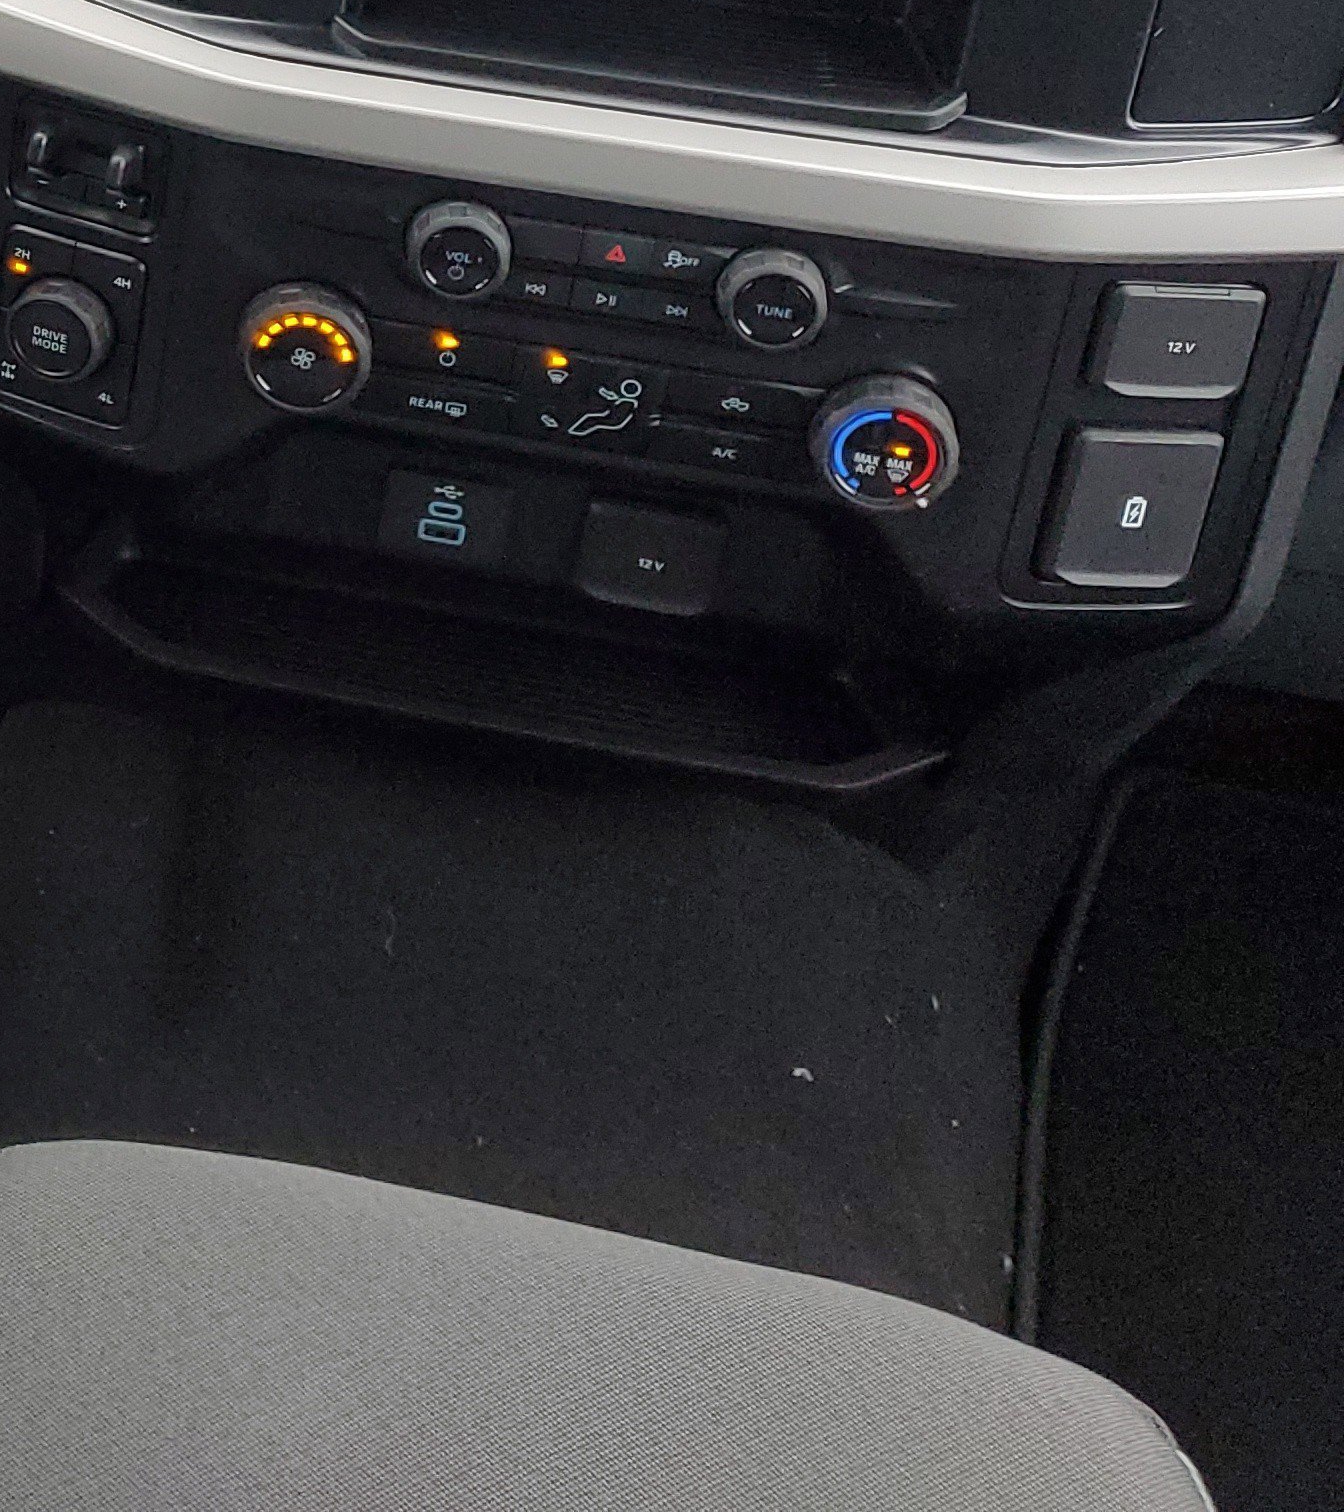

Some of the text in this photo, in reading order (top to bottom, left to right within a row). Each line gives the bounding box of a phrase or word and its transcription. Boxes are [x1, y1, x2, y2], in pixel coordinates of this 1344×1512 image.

[13, 247, 30, 260] 2H
[445, 250, 471, 264] VOL
[113, 276, 132, 290] 4H
[756, 303, 793, 320] TUNE
[32, 325, 68, 344] DRIVE
[31, 336, 68, 354] MODE
[97, 392, 115, 405] 4L
[409, 396, 443, 411] REAR
[712, 446, 737, 461] A/C
[853, 452, 880, 466] MAX
[855, 463, 876, 476] A/C
[886, 458, 913, 472] MAX
